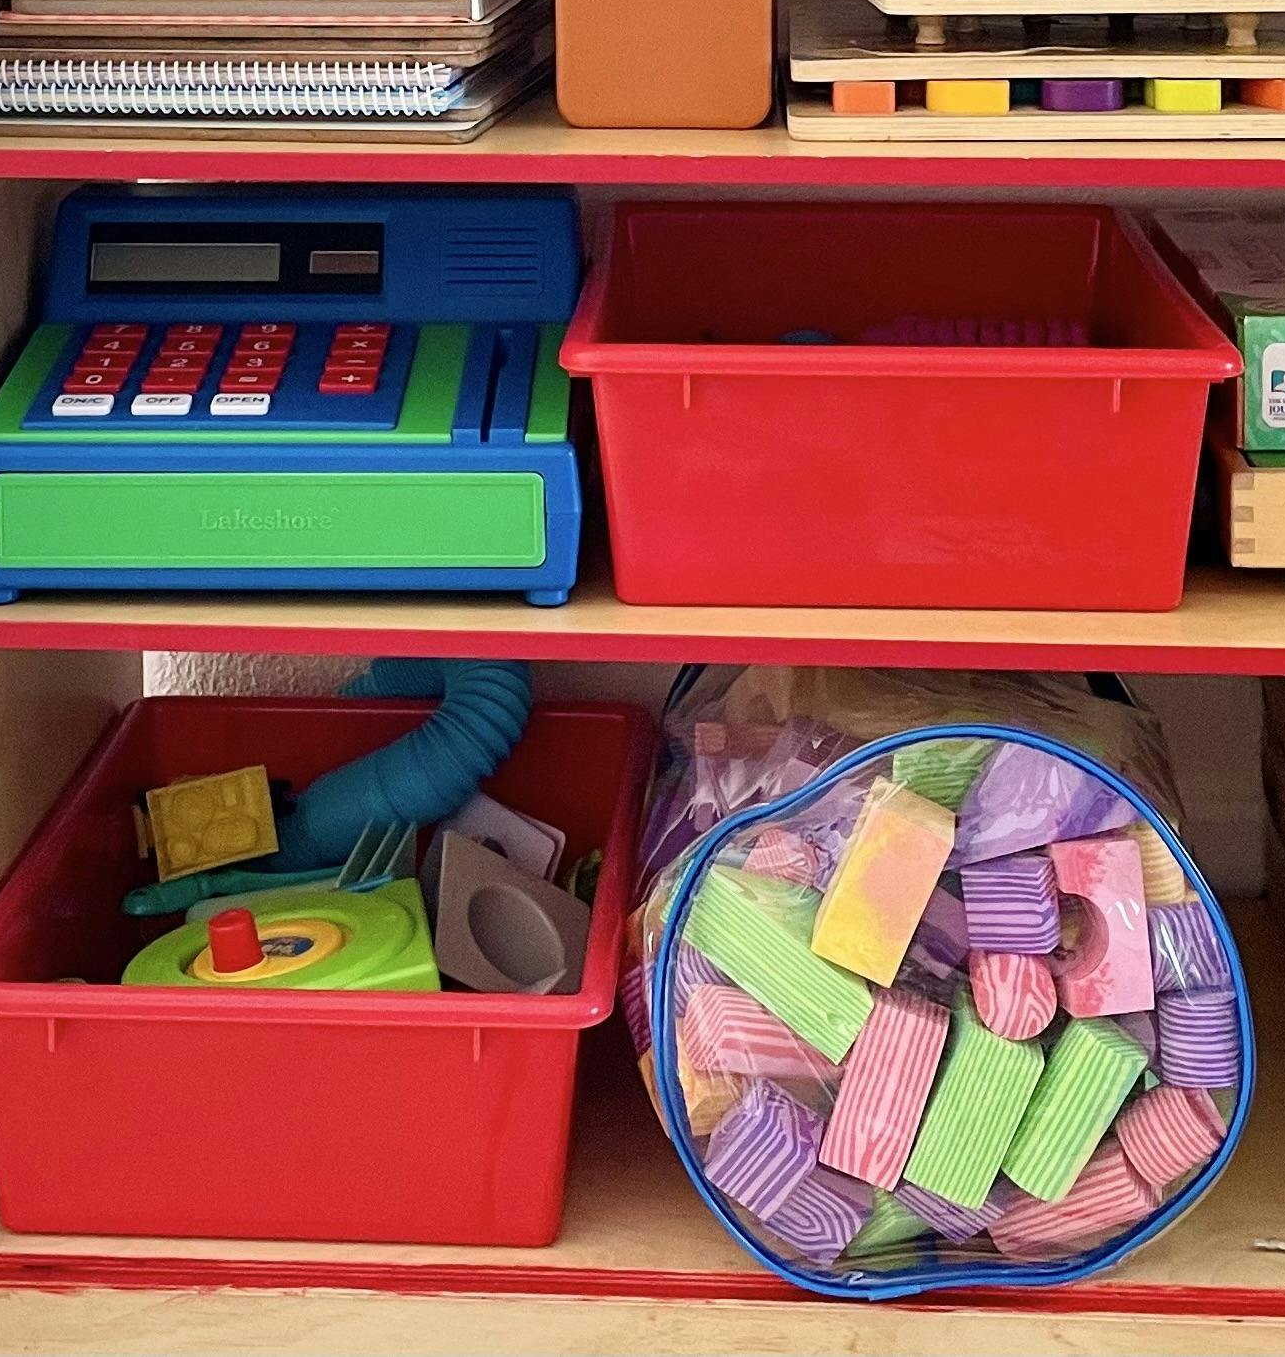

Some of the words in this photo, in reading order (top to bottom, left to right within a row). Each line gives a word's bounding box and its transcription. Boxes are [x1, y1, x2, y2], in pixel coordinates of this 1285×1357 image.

[61, 396, 105, 404] ON/C
[145, 396, 180, 404] OFF
[216, 395, 265, 404] OPEN
[199, 507, 332, 530] Lakeshore
